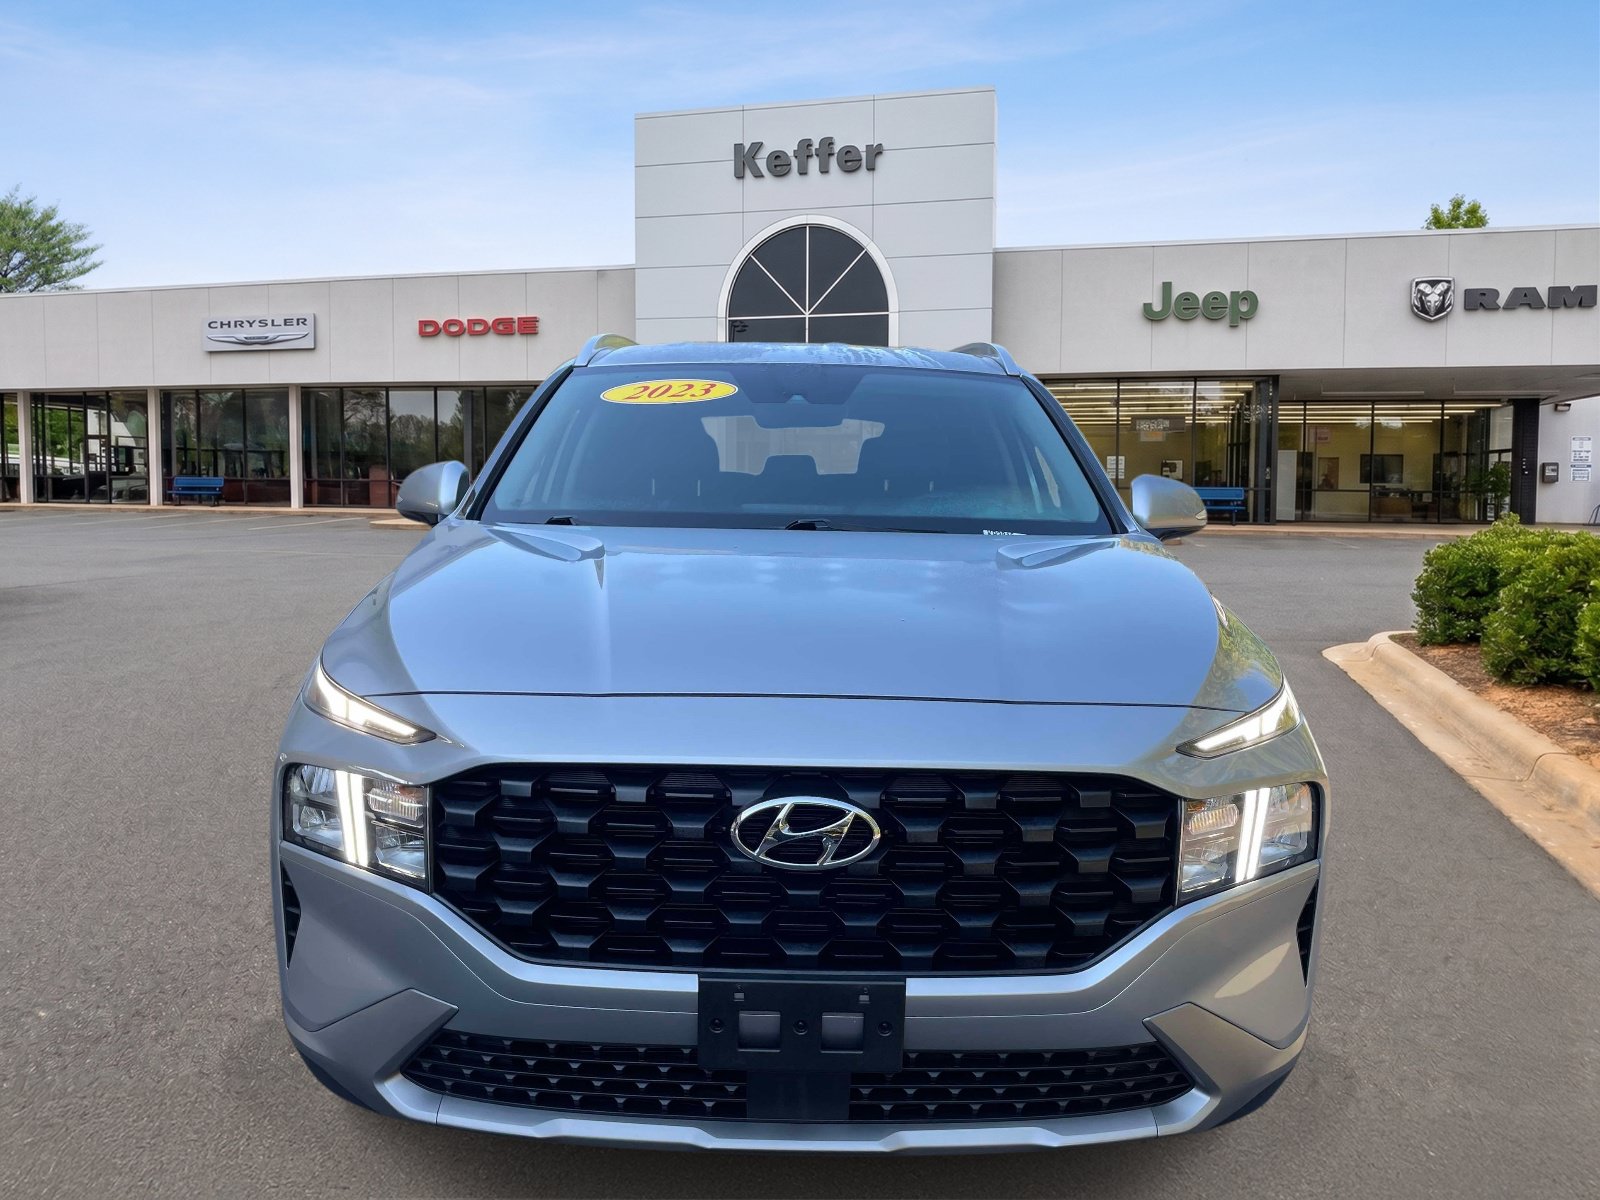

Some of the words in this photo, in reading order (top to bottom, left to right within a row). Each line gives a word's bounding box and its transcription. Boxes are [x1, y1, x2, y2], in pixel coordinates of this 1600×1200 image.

[733, 136, 884, 179] Keffer
[1143, 281, 1259, 328] Jeep
[1463, 284, 1598, 311] RAM
[207, 317, 308, 330] CHRYSLER
[418, 316, 539, 337] DODGE
[623, 383, 717, 401] 2023
